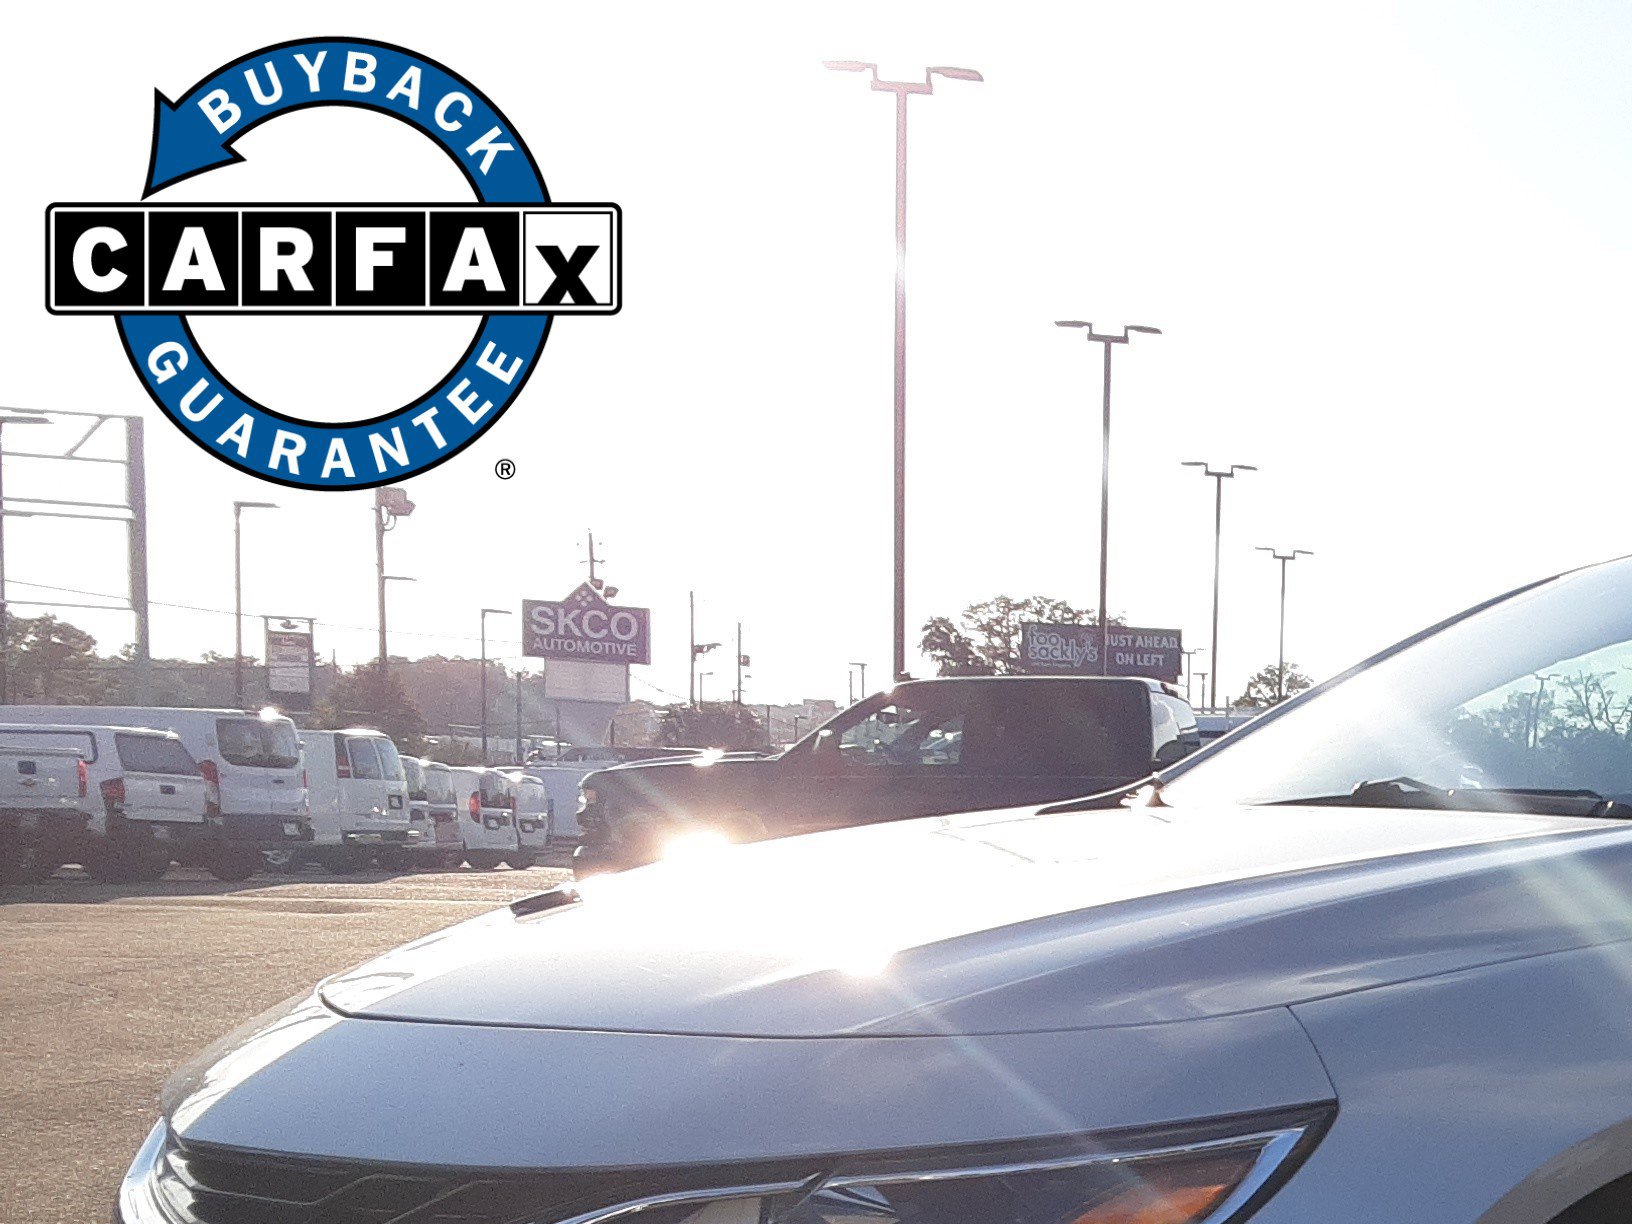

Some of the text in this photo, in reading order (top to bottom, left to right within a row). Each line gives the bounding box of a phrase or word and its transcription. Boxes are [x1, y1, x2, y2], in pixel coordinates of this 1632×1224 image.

[530, 605, 639, 641] SKCO
[533, 637, 637, 657] AUTOMOTIVE
[1115, 652, 1165, 667] ON LEFT
